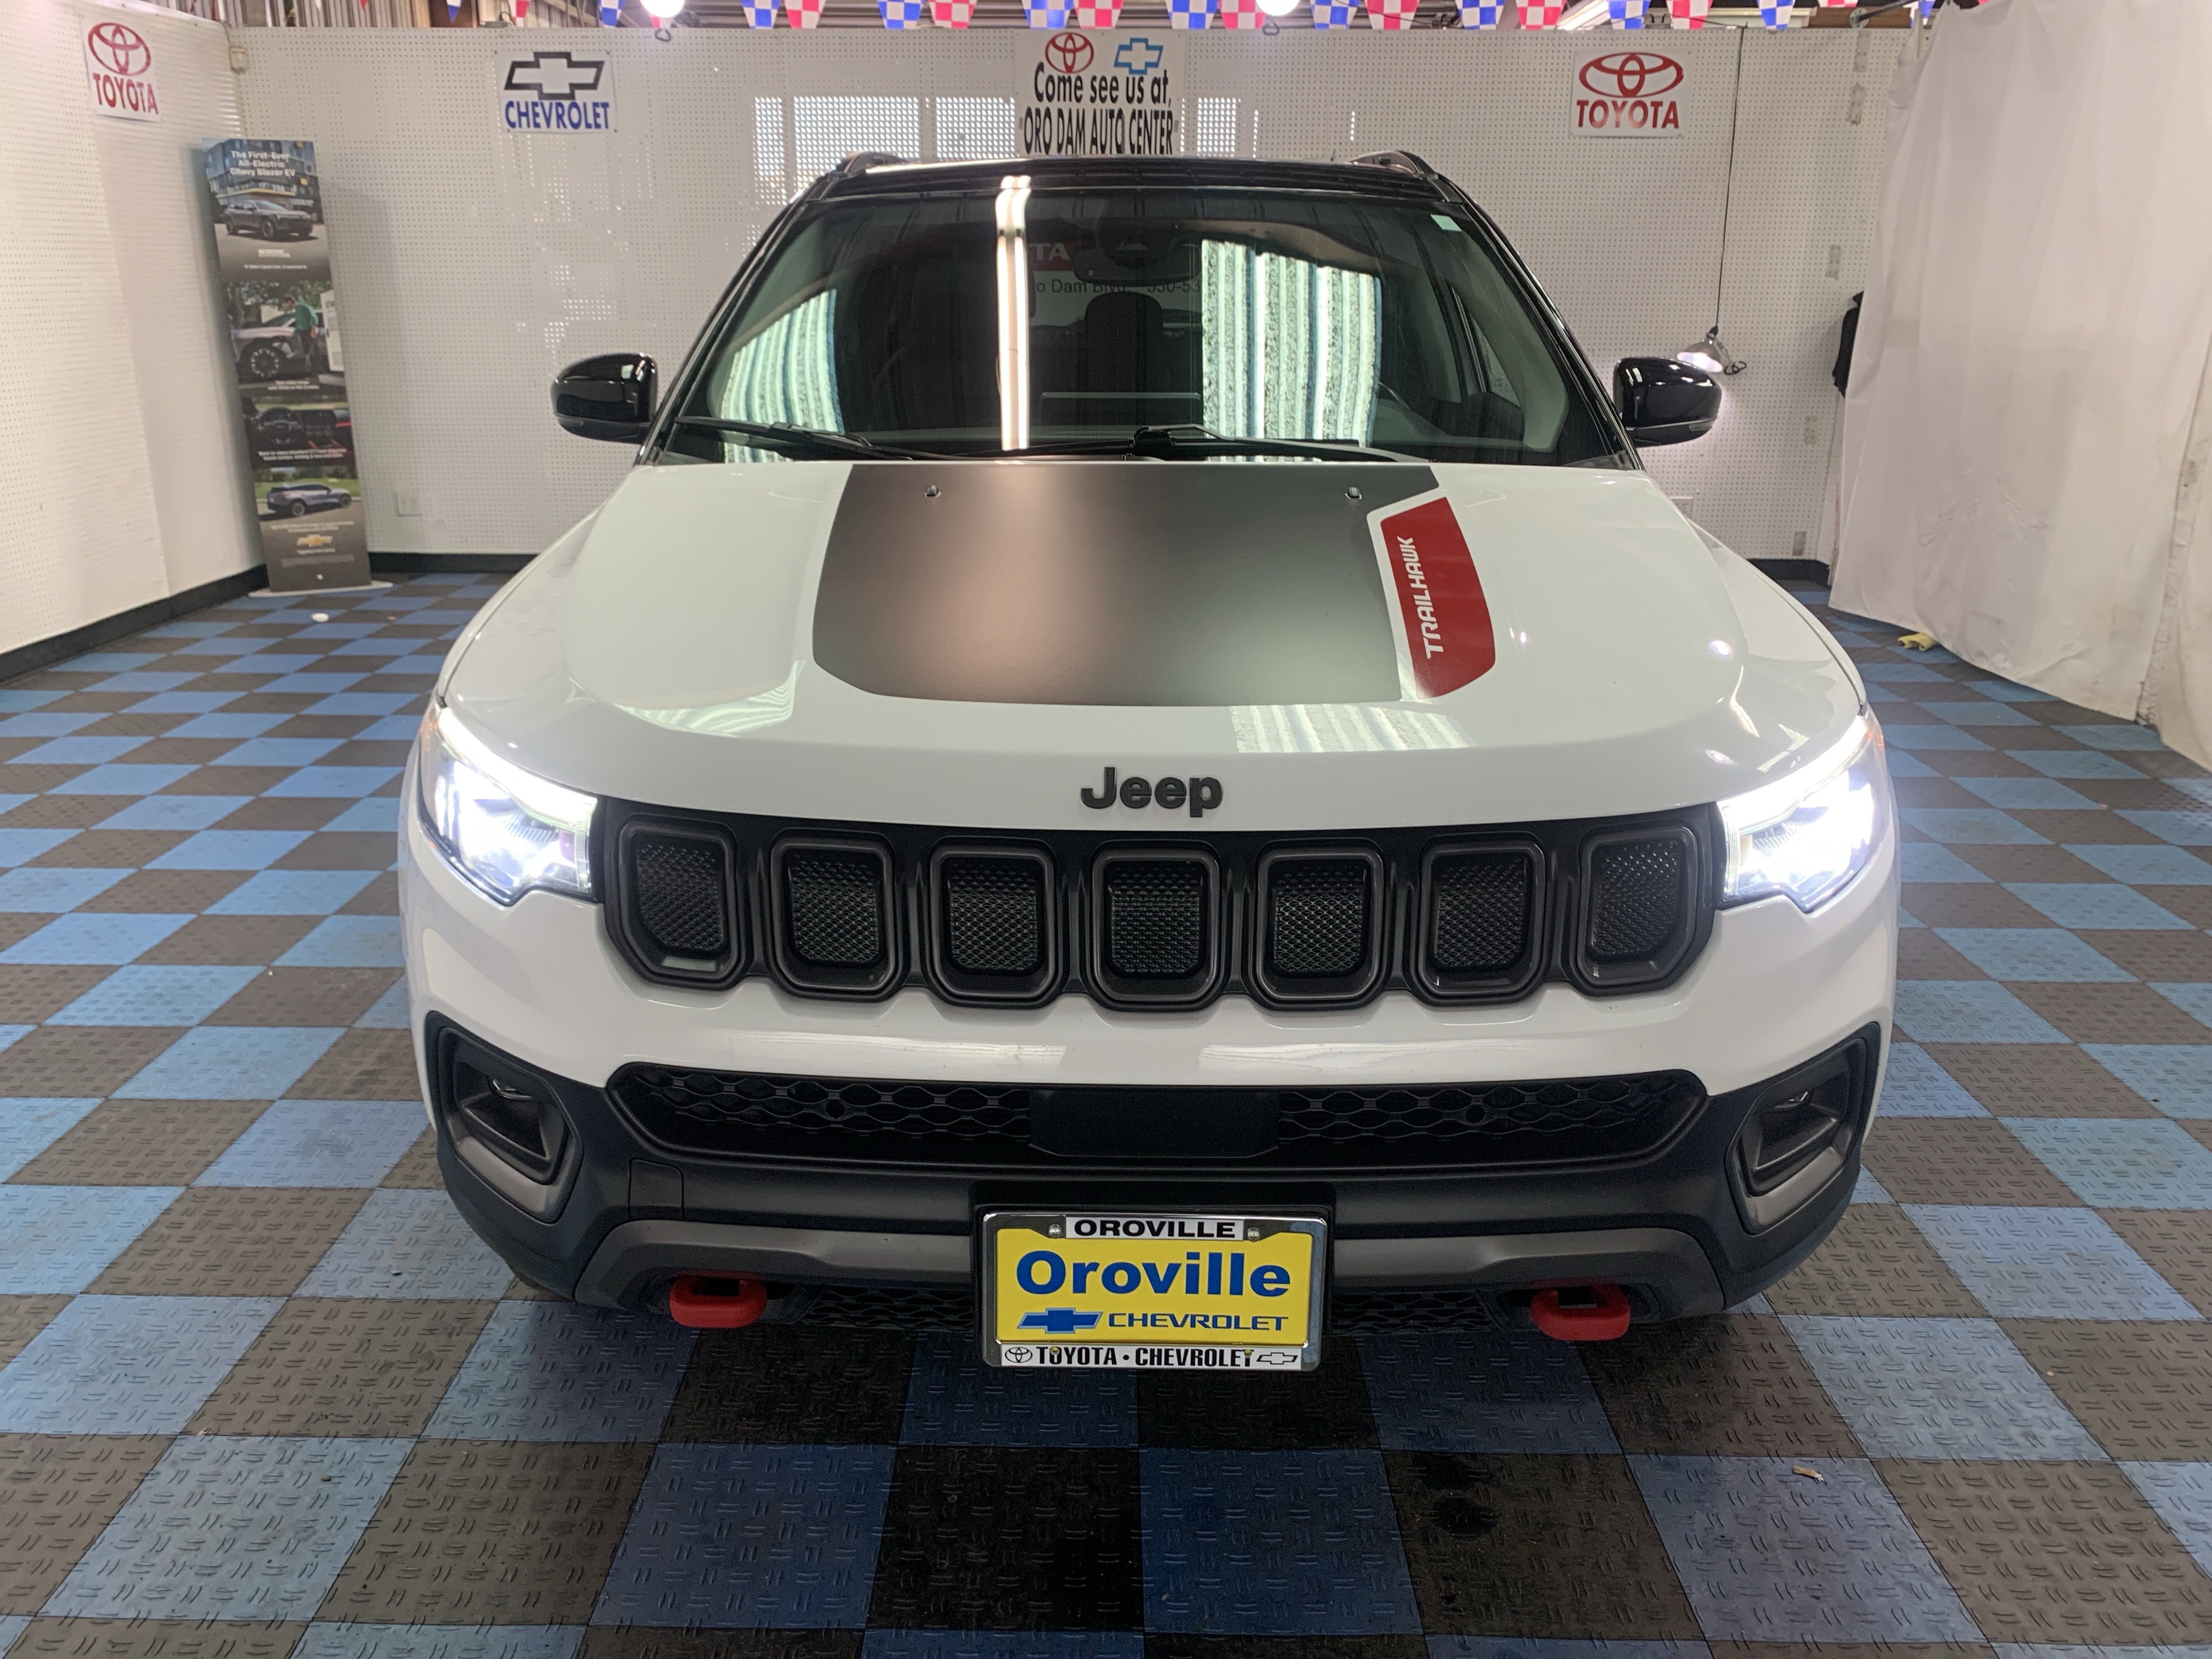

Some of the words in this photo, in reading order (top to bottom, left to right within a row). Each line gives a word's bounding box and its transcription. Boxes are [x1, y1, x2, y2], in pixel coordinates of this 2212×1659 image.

[92, 72, 159, 115] TOYOTA
[1034, 61, 1084, 103] Come
[1090, 75, 1119, 104] see
[1126, 76, 1144, 105] us
[505, 100, 610, 129] CHEVROLET
[1057, 108, 1086, 155] DAM
[1090, 108, 1125, 155] AUTO
[1577, 99, 1679, 129] TOYOTA
[1052, 279, 1087, 293] Dam
[1397, 535, 1444, 659] TRAILHAWK
[1080, 766, 1224, 817] Jeep
[1074, 1218, 1235, 1239] OROVILLE
[1017, 1250, 1291, 1297] Oroville
[1108, 1312, 1289, 1331] CHEVROLET
[1036, 1345, 1118, 1366] TOYOTA
[1135, 1347, 1255, 1368] CHEVROLET
